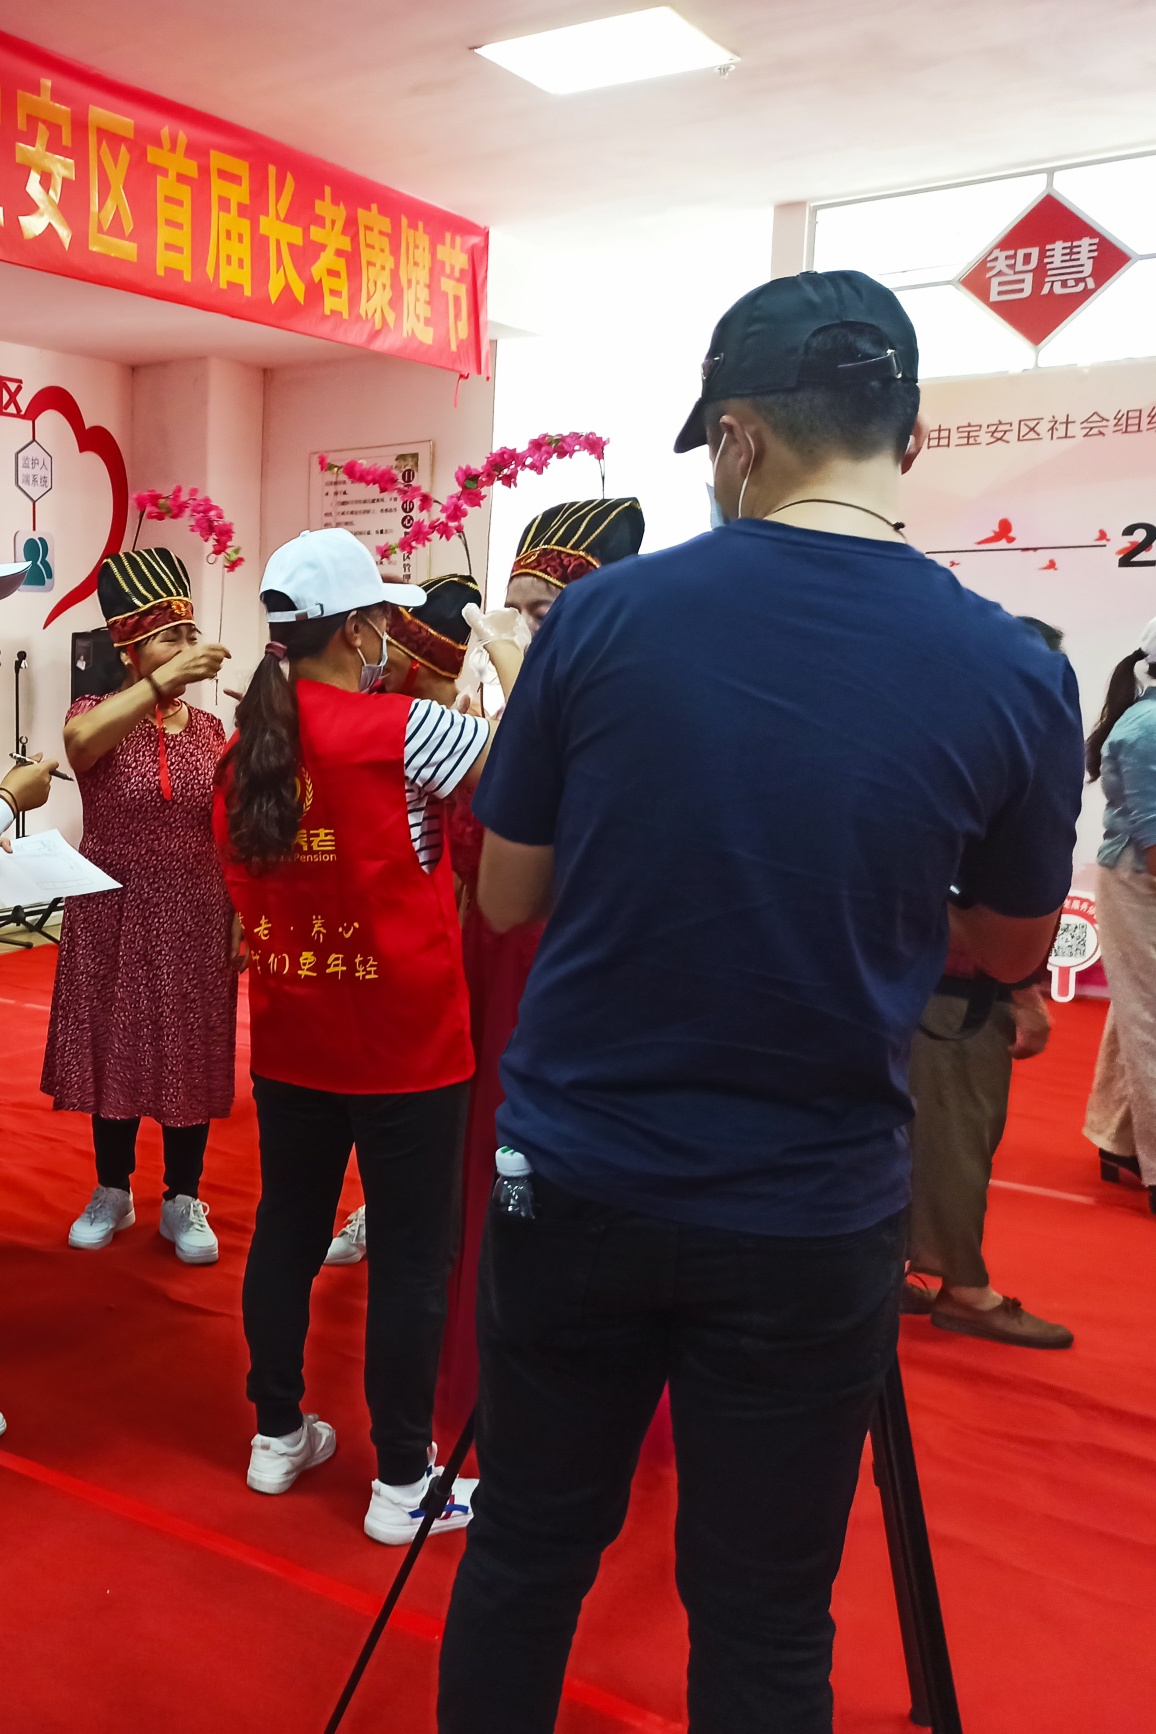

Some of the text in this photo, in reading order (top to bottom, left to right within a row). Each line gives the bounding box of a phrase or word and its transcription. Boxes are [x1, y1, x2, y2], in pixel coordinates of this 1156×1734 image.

[985, 236, 1100, 303] 智慧
[21, 456, 48, 471] 监护人
